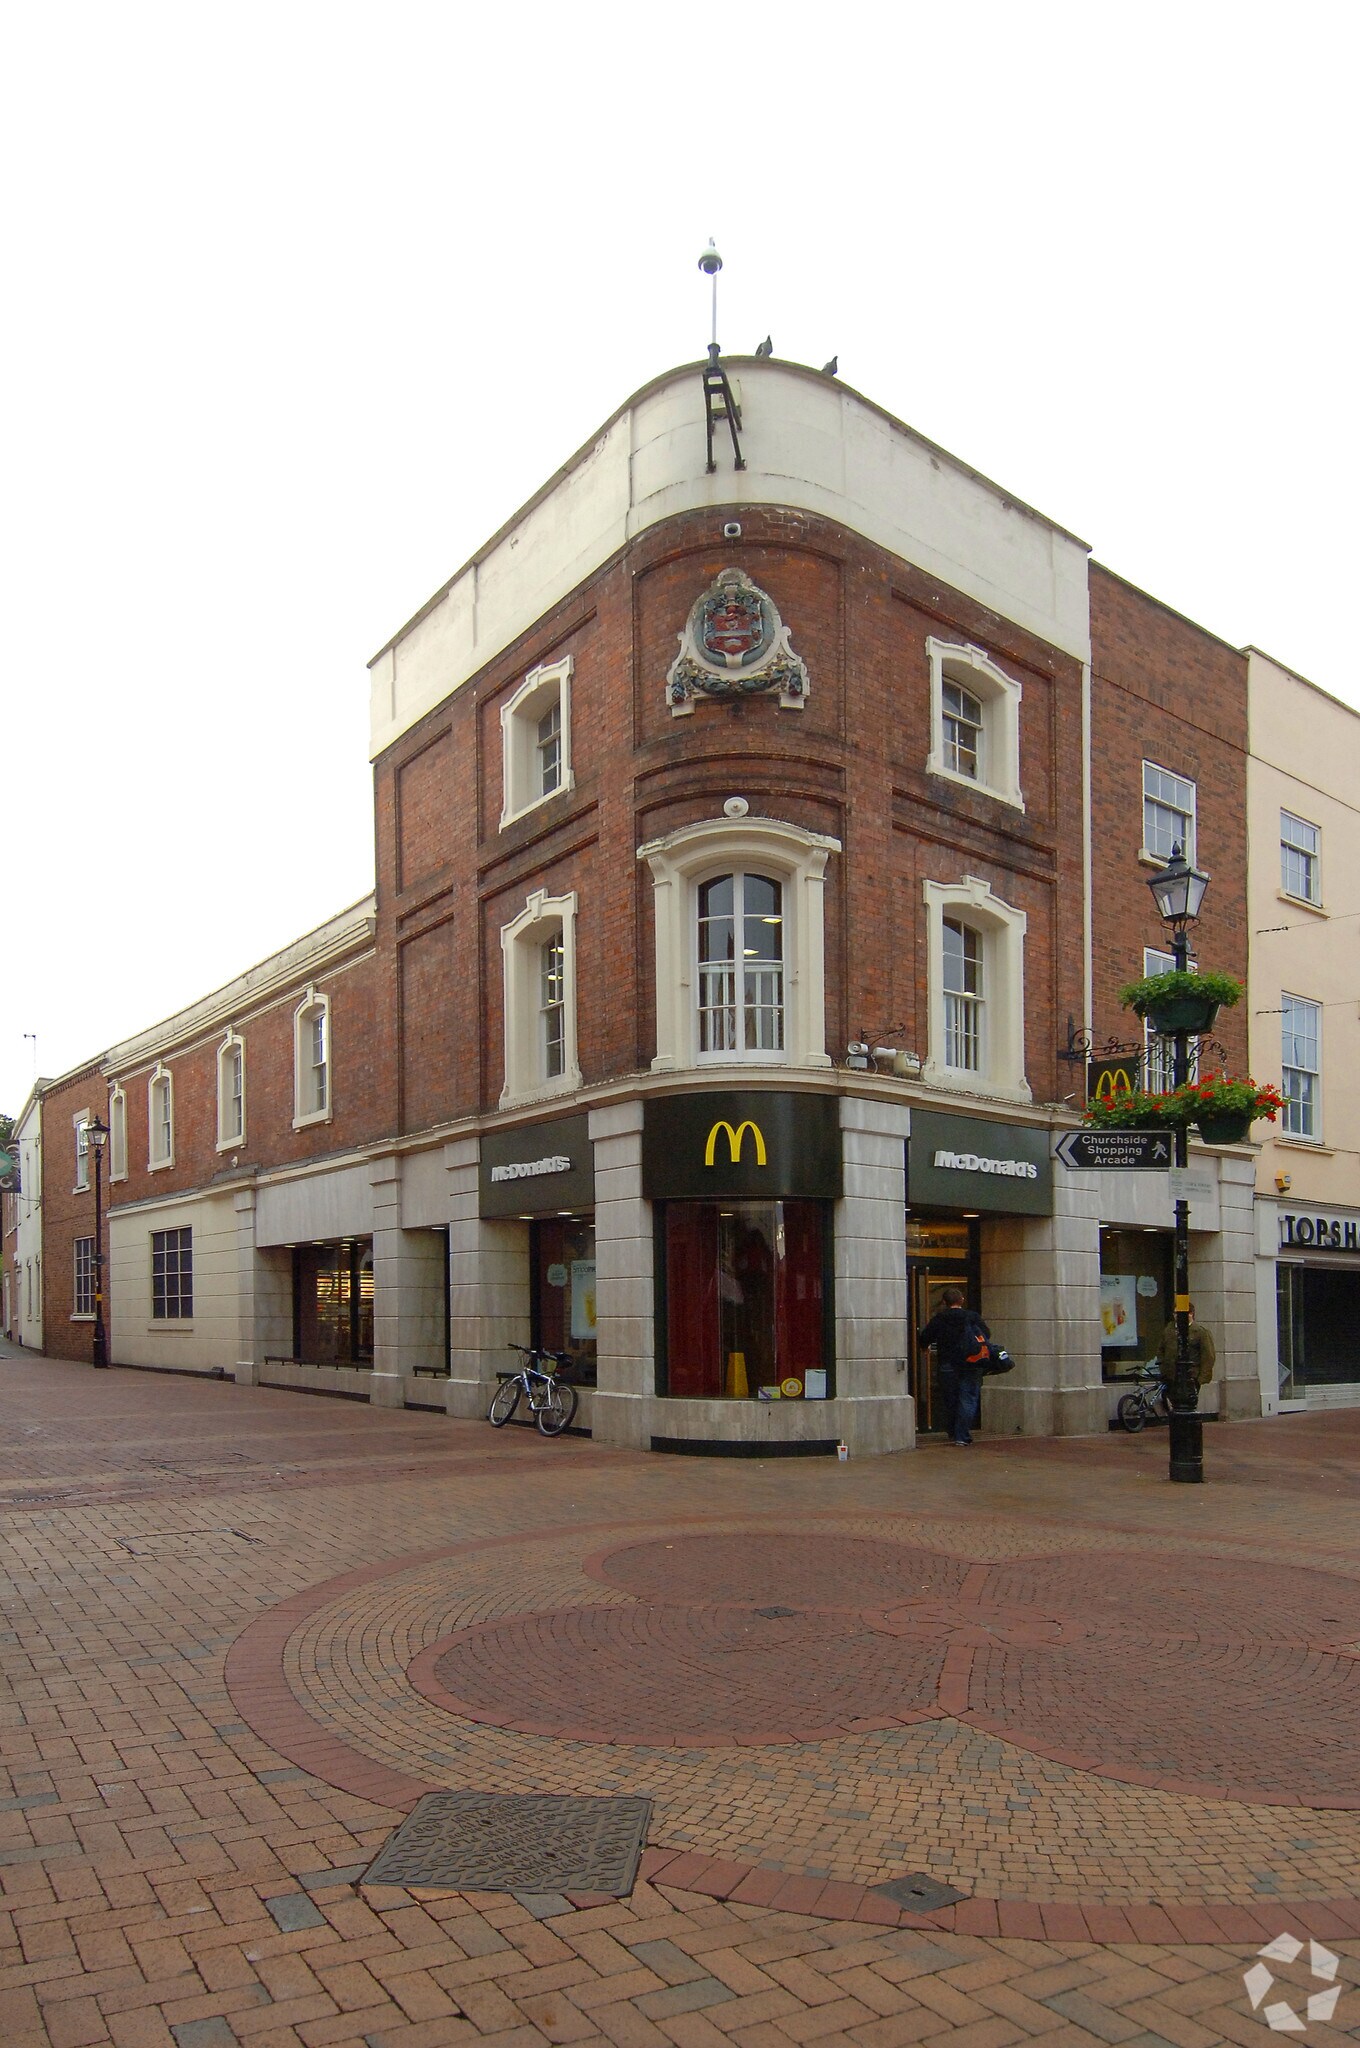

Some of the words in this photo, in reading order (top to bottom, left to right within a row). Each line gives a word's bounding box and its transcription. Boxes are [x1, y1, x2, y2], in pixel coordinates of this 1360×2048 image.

[1082, 1135, 1148, 1144] Churchside
[1087, 1146, 1142, 1155] Shopping
[934, 1150, 1038, 1179] McDonald's
[1094, 1156, 1135, 1164] Arcade
[491, 1156, 571, 1182] McDonald's
[1284, 1215, 1360, 1248] TOPSH
